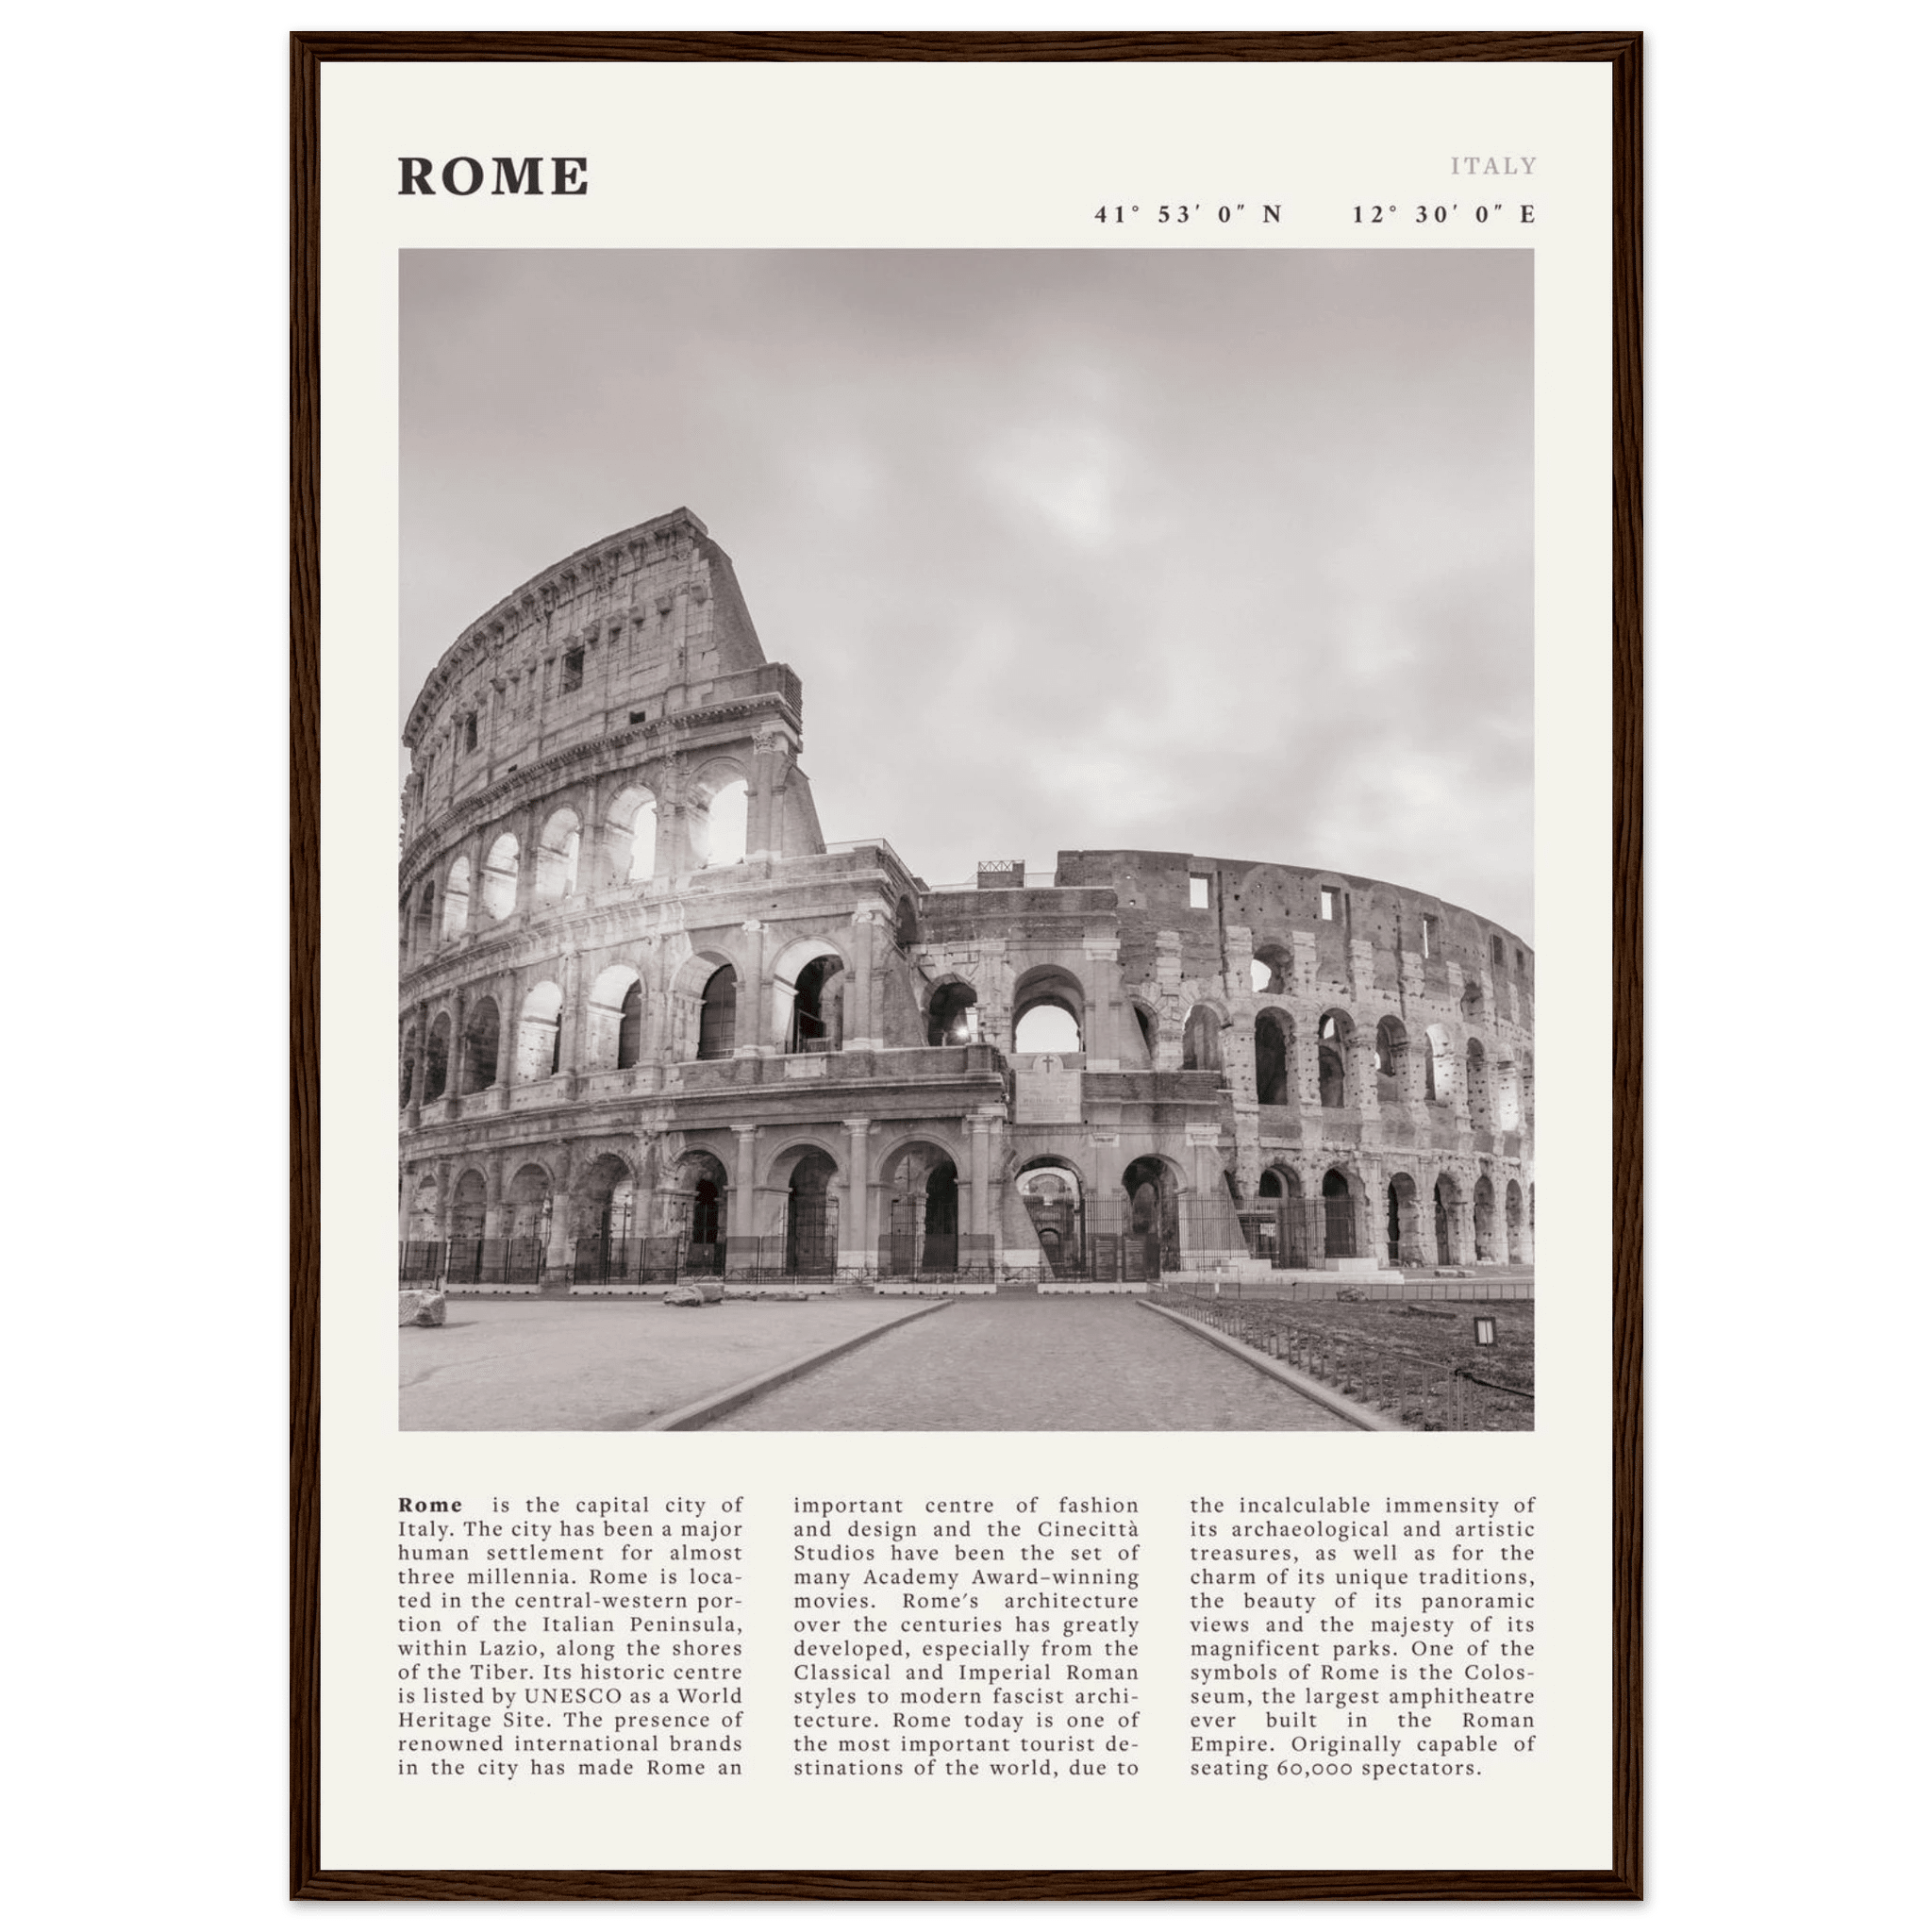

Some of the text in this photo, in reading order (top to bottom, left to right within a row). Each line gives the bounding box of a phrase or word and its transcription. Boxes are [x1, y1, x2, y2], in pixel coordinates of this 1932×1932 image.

[397, 156, 589, 196] ROME
[1451, 157, 1537, 175] ITALY
[1262, 204, 1282, 224] N
[1520, 204, 1536, 224] E
[397, 1495, 744, 1519] Rome is the capital city of
[793, 1495, 1139, 1519] important centre of fashion
[1190, 1495, 1537, 1519] the incalculable immensity of
[398, 1520, 743, 1542] Italy. The city has been a major
[793, 1520, 1139, 1542] and design and the Cinecittà
[1191, 1520, 1535, 1542] its archaeological and artistic
[397, 1543, 742, 1561] human settlement for almost
[1190, 1543, 1535, 1564] treasures, as well as for the
[793, 1573, 851, 1591] many
[862, 1567, 959, 1591] Academy
[1190, 1567, 1535, 1591] charm of its unique traditions,
[397, 1591, 742, 1614] ted in the central-western por-
[793, 1591, 875, 1609] movies.
[1004, 1591, 1139, 1609] architecture
[1190, 1591, 1535, 1614] the beauty of its panoramic
[793, 1615, 1140, 1638] over the centuries has greatly
[397, 1639, 742, 1662] within Lazio, along the shores
[793, 1639, 1139, 1662] developed, especially from the
[1191, 1639, 1535, 1662] magnificent parks. One of the
[793, 1663, 1139, 1686] Classical and Imperial Roman
[1191, 1662, 1535, 1686] symbols of Rome is the Colos-
[398, 1686, 742, 1709] is listed by UNESCO as a World
[1191, 1687, 1535, 1709] seum, the largest amphitheatre
[398, 1710, 744, 1733] Heritage Site. The presence of
[793, 1710, 1141, 1734] tecture. Rome today is one of
[398, 1734, 742, 1752] renowned international brands
[793, 1734, 1139, 1757] the most important tourist de-
[1191, 1734, 1537, 1757] Empire. Originally capable of
[398, 1757, 741, 1781] in the city has made Rome an
[793, 1757, 1139, 1778] stinations of the world, due to
[1191, 1758, 1482, 1781] seating 60,000 spectators.
